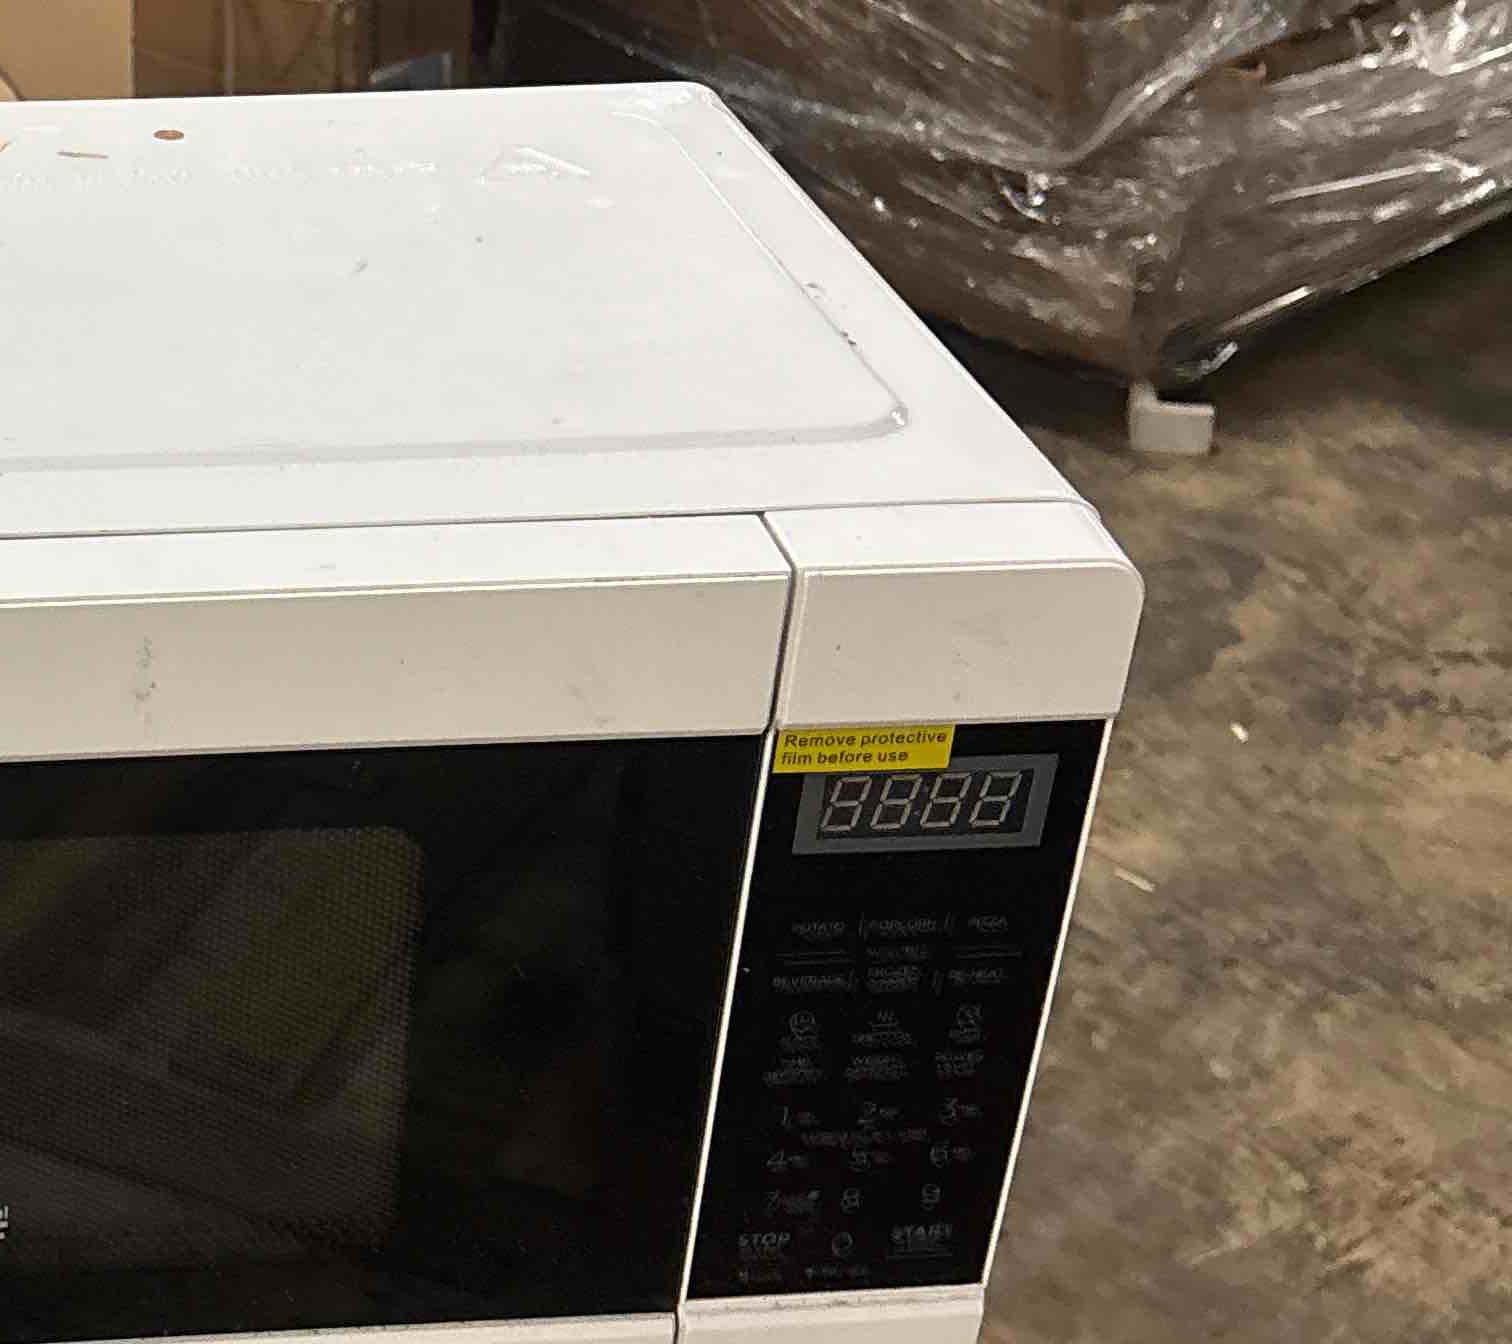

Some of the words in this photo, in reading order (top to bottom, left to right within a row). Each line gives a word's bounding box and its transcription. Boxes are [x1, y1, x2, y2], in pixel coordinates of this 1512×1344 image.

[784, 733, 857, 748] Remove
[861, 730, 948, 748] protective
[781, 751, 813, 766] film
[816, 750, 873, 765] before
[877, 750, 909, 763] use
